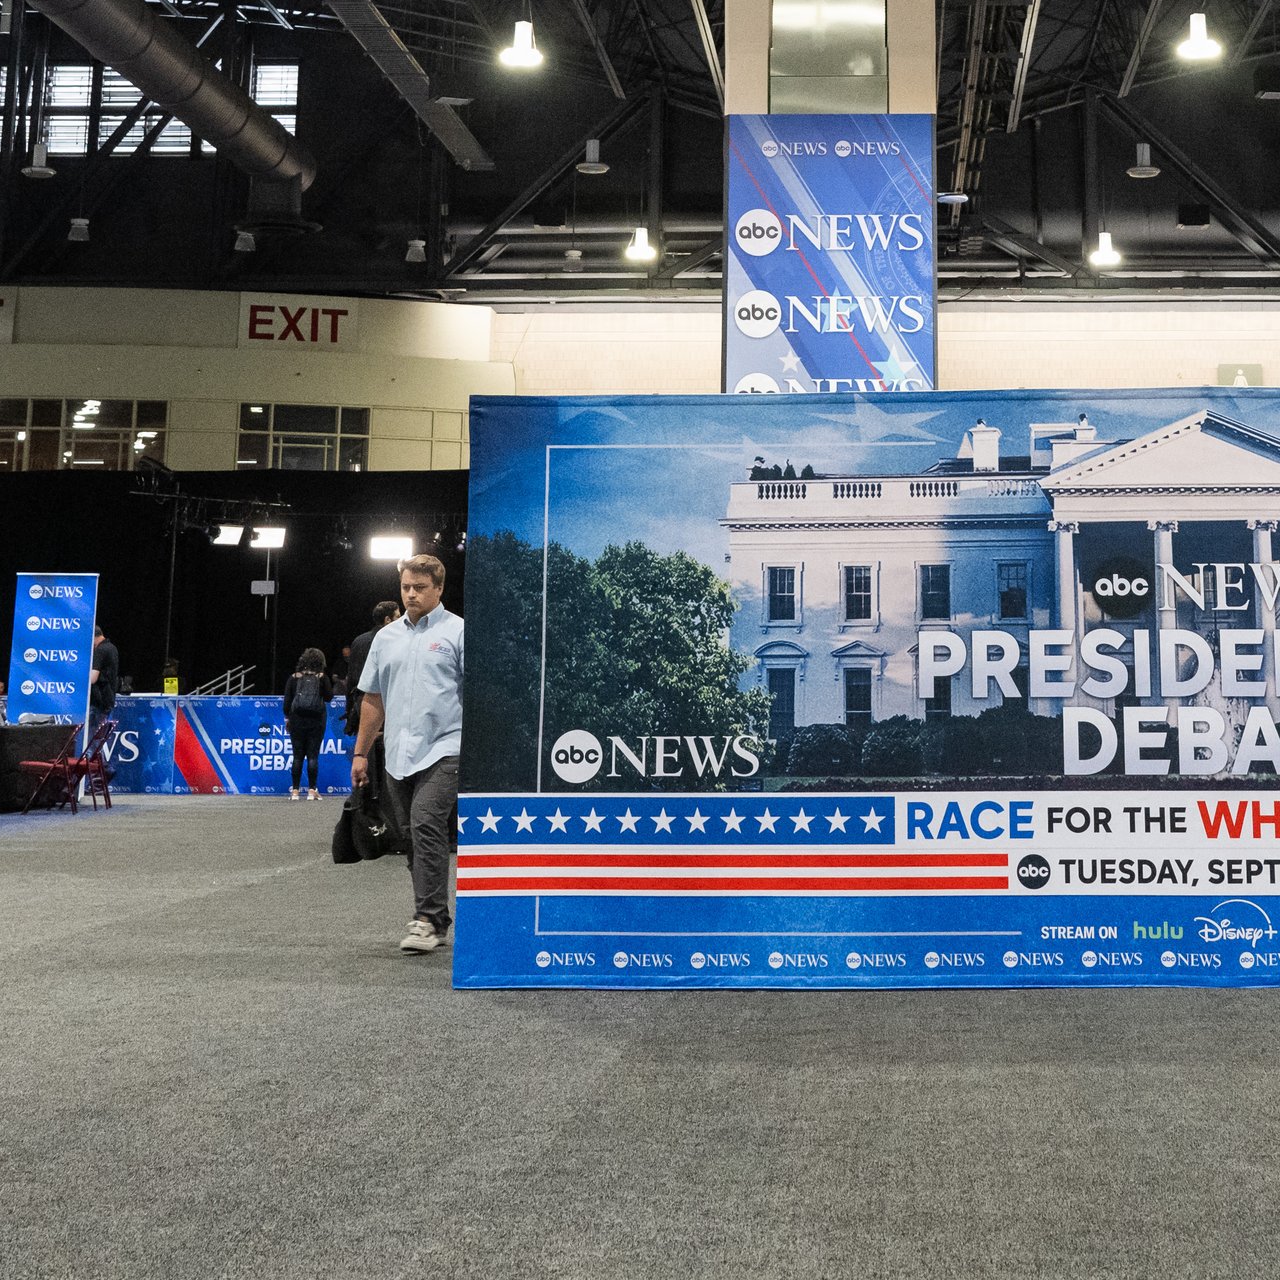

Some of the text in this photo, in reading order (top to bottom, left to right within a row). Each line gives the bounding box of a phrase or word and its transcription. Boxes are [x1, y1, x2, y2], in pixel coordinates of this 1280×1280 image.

[780, 142, 827, 156] NEWS
[852, 141, 900, 155] NEWS
[739, 213, 923, 251] abc NEWS
[248, 304, 349, 343] EXIT
[738, 295, 924, 333] abc NEWS
[43, 586, 83, 598] NEWS
[1095, 574, 1149, 596] abc
[41, 618, 80, 630] NEWS
[38, 650, 78, 662] NEWS
[35, 682, 75, 694] NEWS
[554, 736, 761, 779] abc NEWS
[907, 800, 1035, 841] RACE
[1047, 806, 1113, 834] FOR
[1124, 806, 1187, 834] THE
[1019, 865, 1049, 877] abc
[1059, 858, 1200, 888] TUESDAY,
[1041, 926, 1093, 939] STREAM
[1096, 926, 1118, 939] ON
[1133, 921, 1184, 939] hulu
[552, 952, 595, 967] NEWS
[630, 953, 673, 967] NEWS
[706, 953, 750, 967] NEWS
[784, 953, 828, 967] NEWS
[862, 953, 906, 967] NEWS
[941, 952, 985, 967] NEWS
[1020, 952, 1064, 967] NEWS
[1098, 952, 1143, 967] NEWS
[1178, 952, 1222, 968] NEWS
